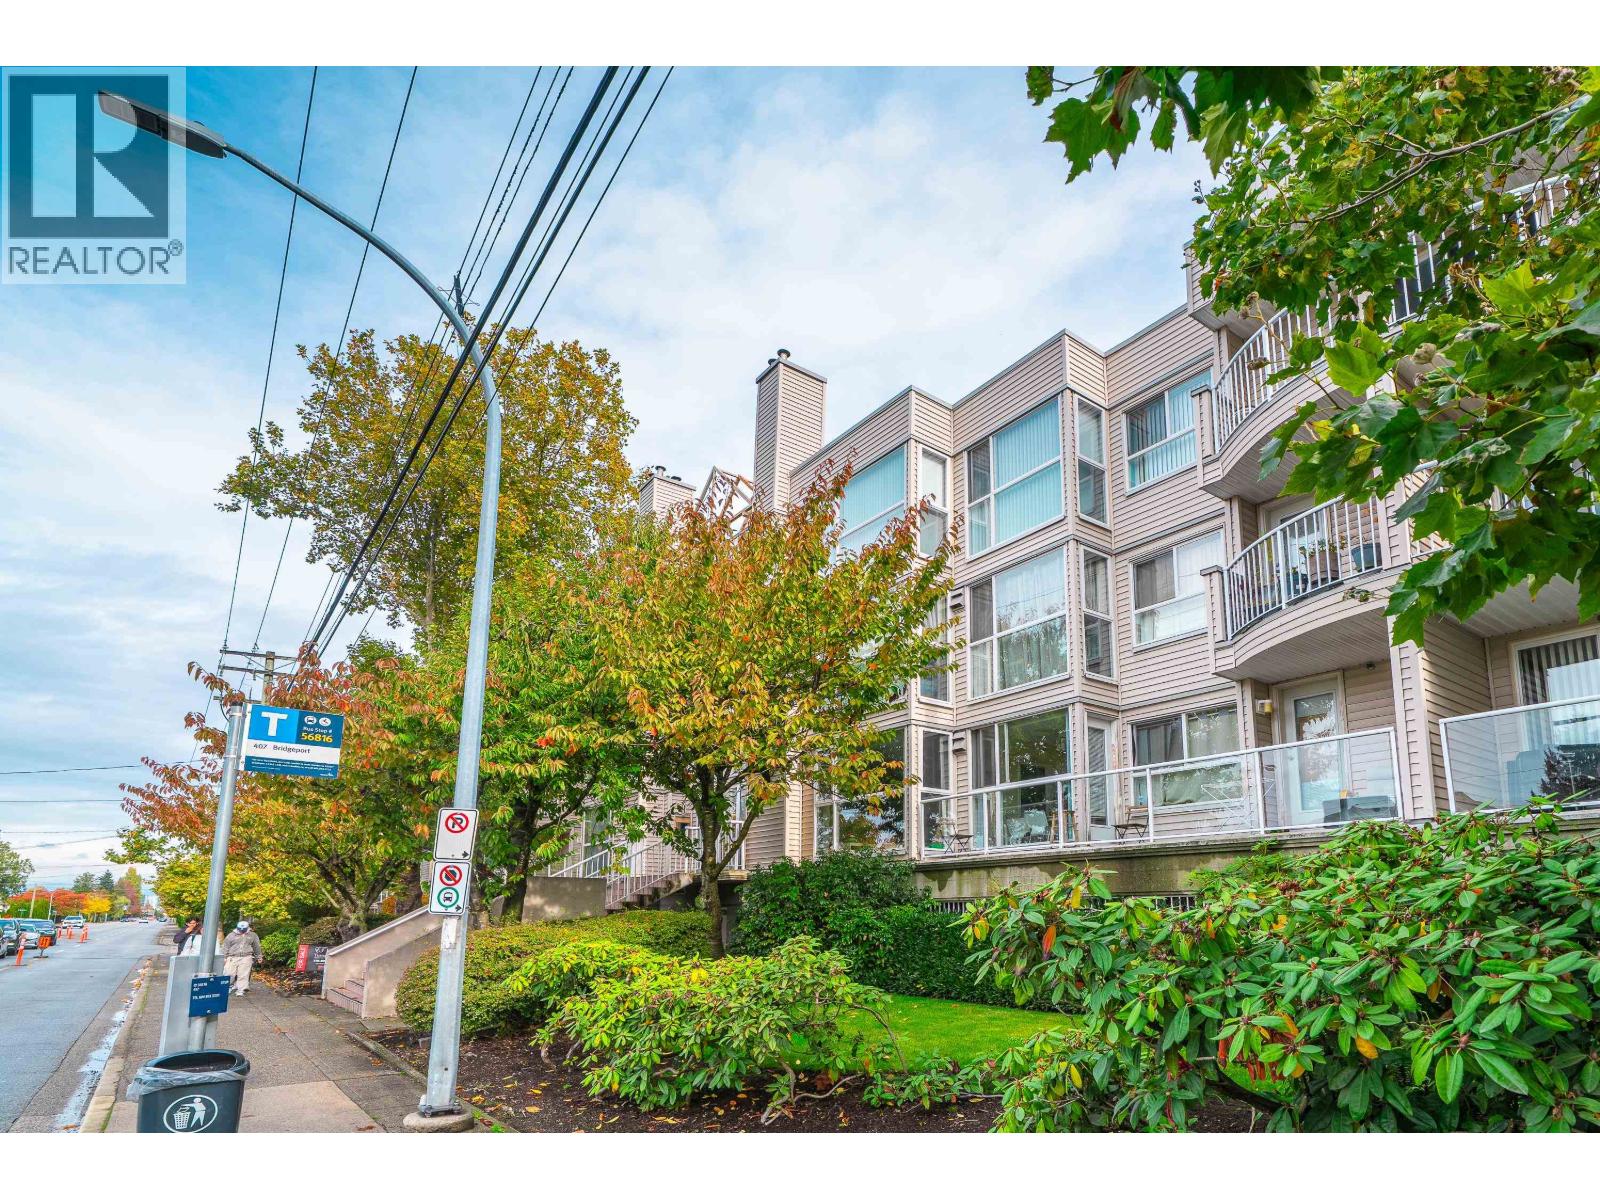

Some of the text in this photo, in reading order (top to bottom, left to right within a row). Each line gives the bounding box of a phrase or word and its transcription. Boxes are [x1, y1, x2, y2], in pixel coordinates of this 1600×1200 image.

[262, 712, 288, 736] T
[301, 732, 333, 743] 56816
[272, 745, 311, 754] Bridgeport
